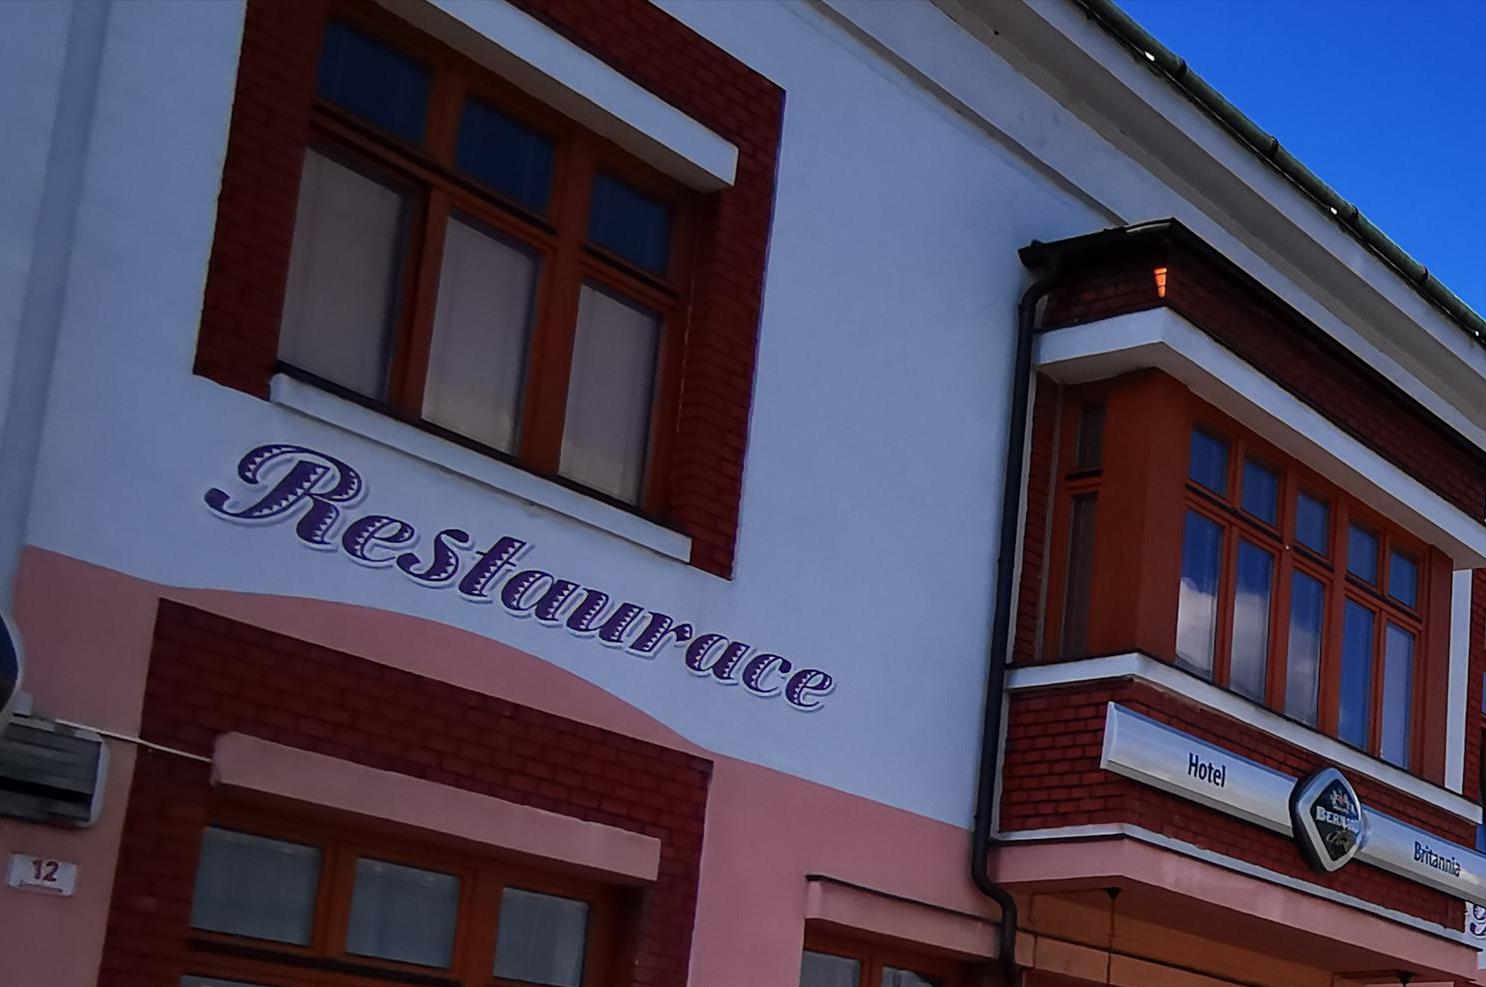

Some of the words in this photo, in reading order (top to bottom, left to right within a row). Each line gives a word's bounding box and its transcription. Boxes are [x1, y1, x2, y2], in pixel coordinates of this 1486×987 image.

[203, 443, 835, 710] Restaurace
[1188, 752, 1226, 788] Hotel
[32, 860, 59, 882] 12
[1413, 840, 1461, 878] Britannia
